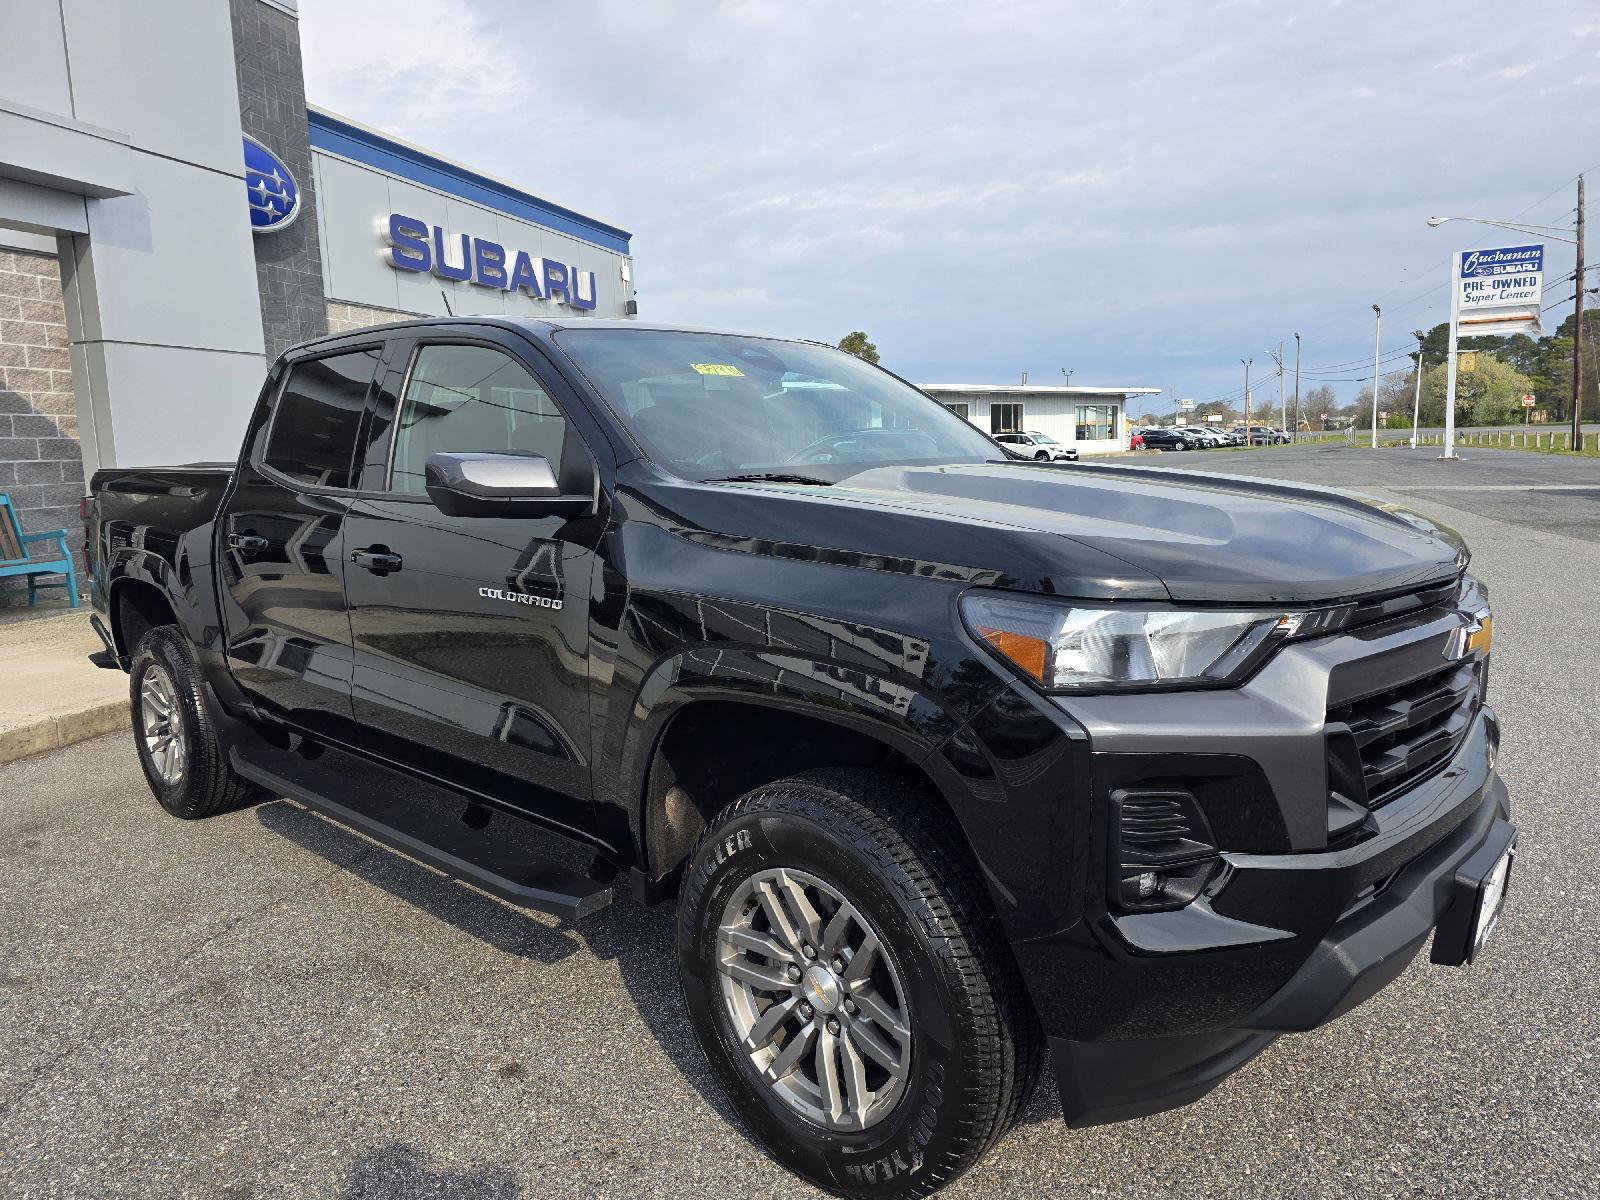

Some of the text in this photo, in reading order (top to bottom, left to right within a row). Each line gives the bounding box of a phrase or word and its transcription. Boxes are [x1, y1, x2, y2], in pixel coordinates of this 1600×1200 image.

[388, 213, 597, 310] SUBARU
[1464, 250, 1541, 273] Buchanan
[1493, 262, 1538, 275] SUBARU
[1463, 276, 1537, 293] PRE-OWNED
[1464, 289, 1536, 305] Super Center
[478, 587, 563, 610] COLORADO
